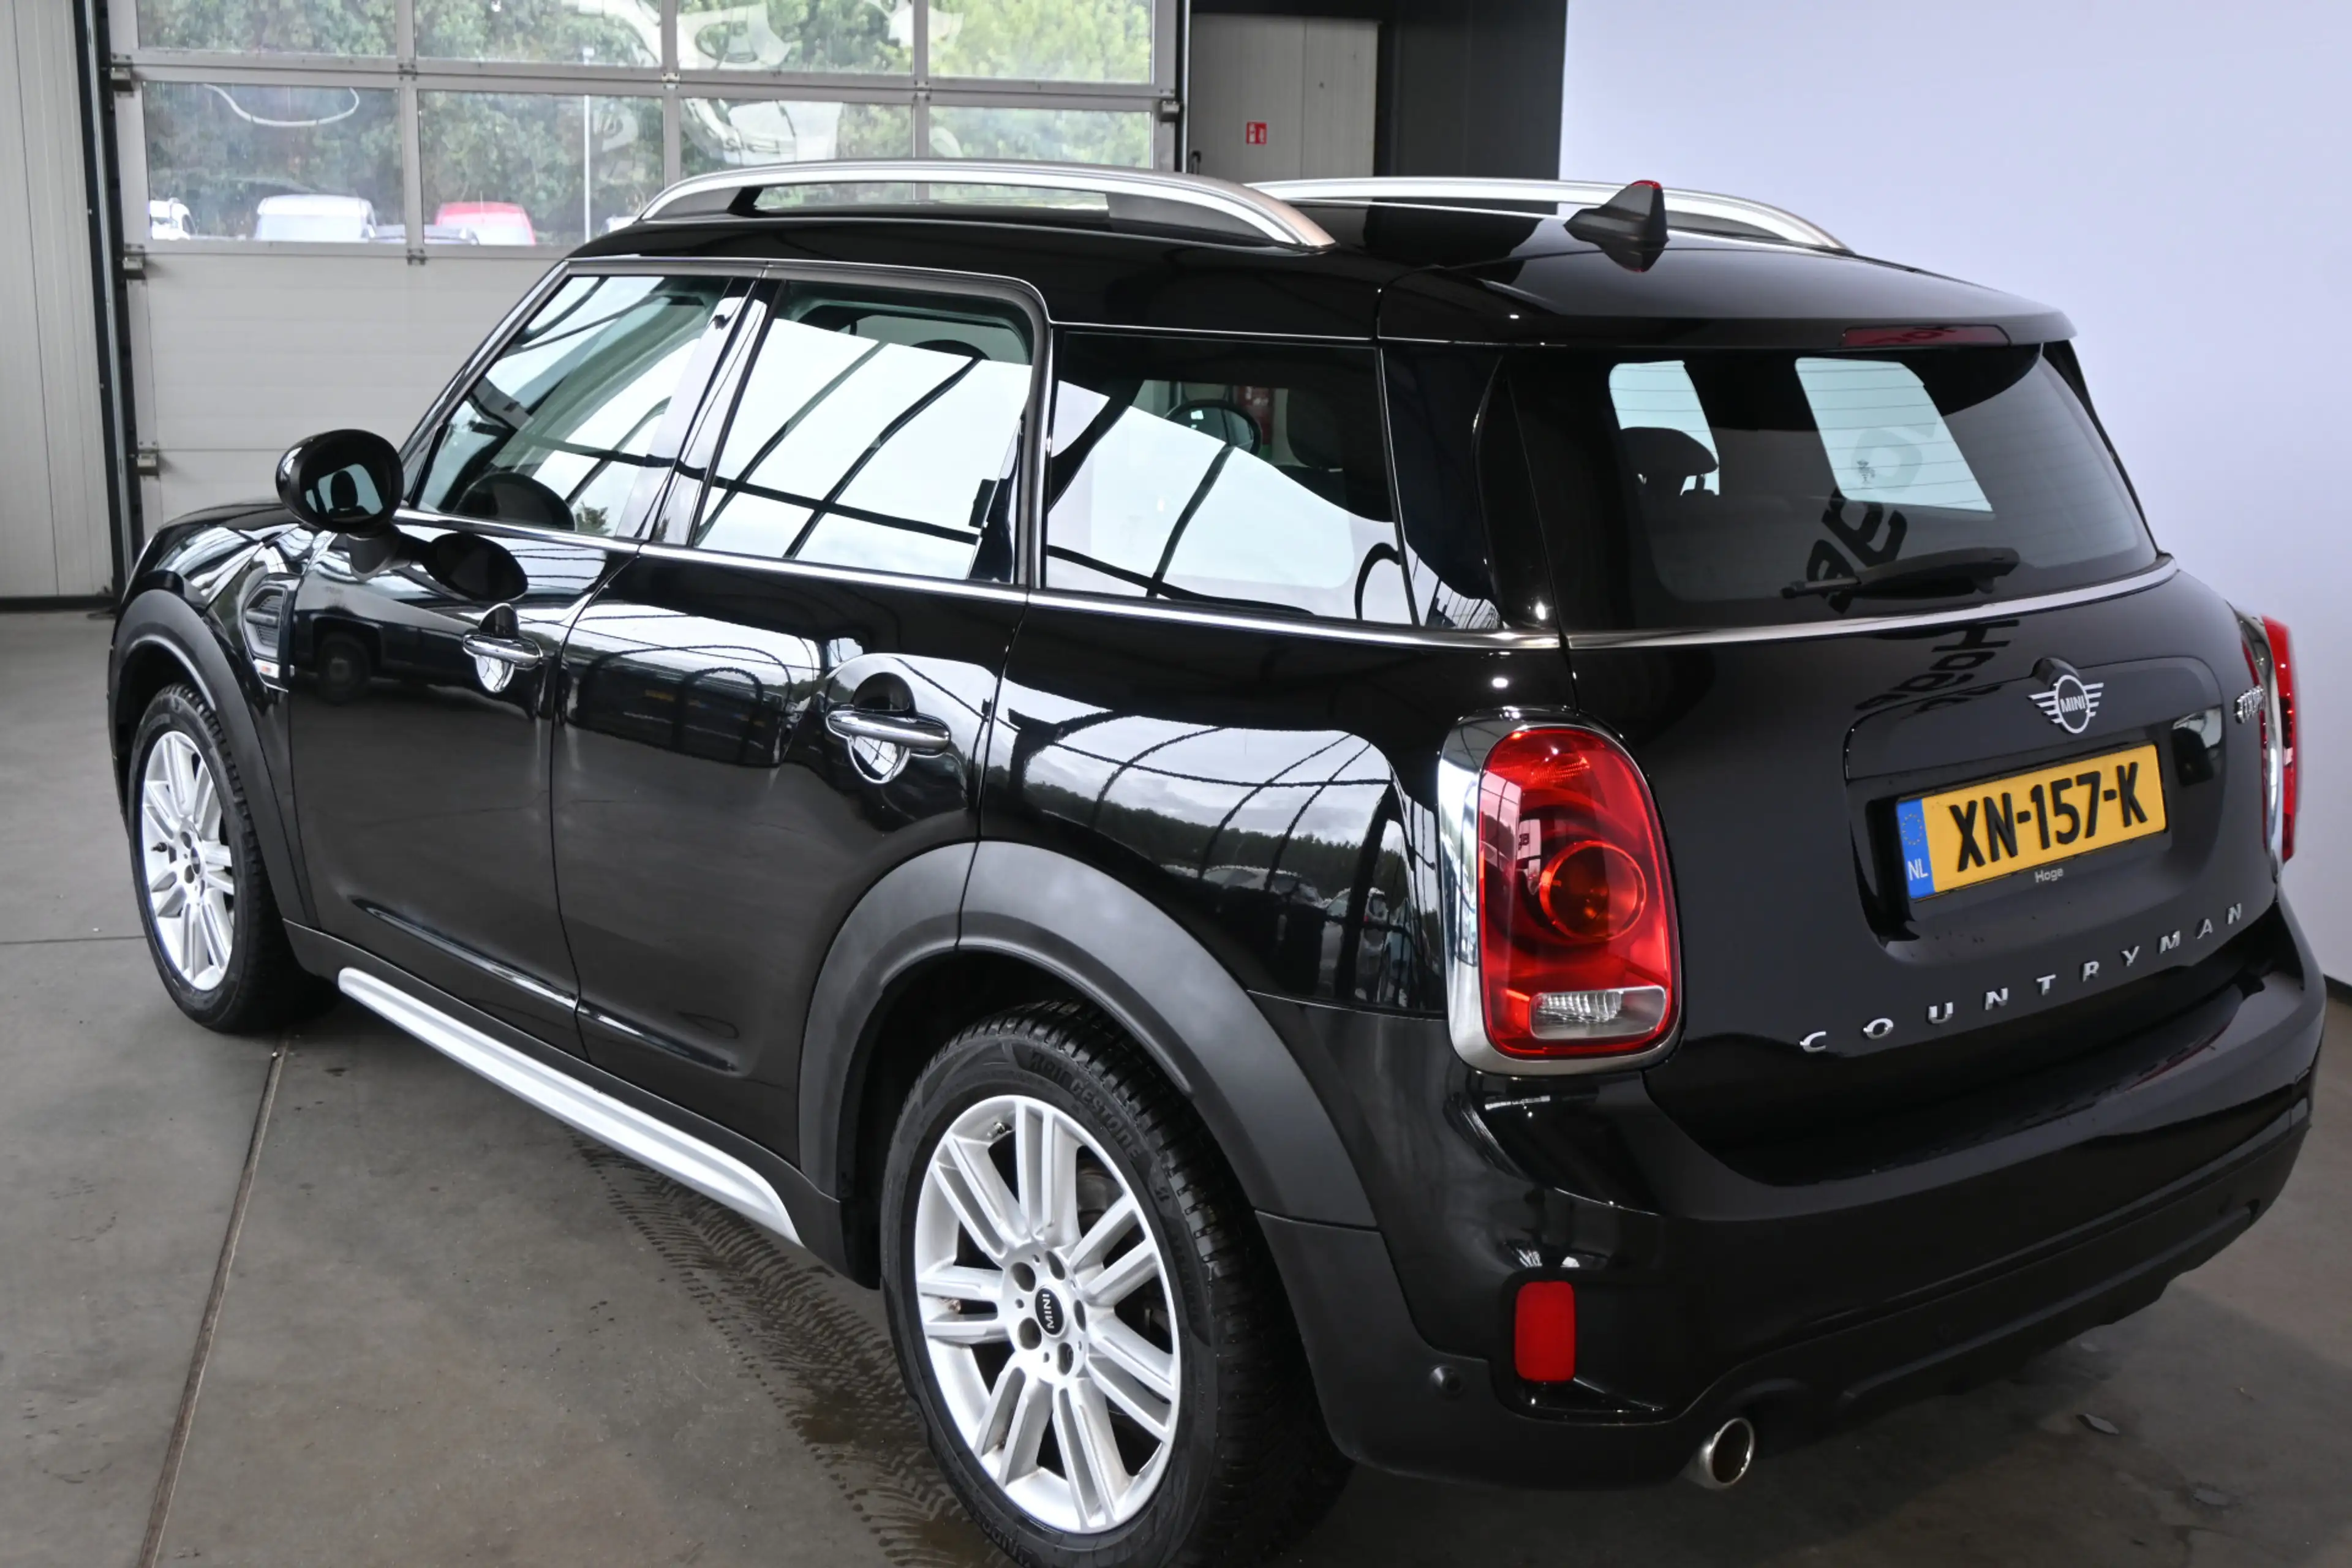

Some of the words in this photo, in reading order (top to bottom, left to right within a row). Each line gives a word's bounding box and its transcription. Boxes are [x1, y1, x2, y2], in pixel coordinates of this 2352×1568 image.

[2060, 695, 2086, 713] MINI
[1948, 762, 2149, 873] XN-157-K
[1907, 858, 1929, 881] NL
[2035, 867, 2064, 883] Hoge
[1800, 902, 2242, 1053] COUNTRYMAN
[1042, 1293, 1055, 1329] MINI
